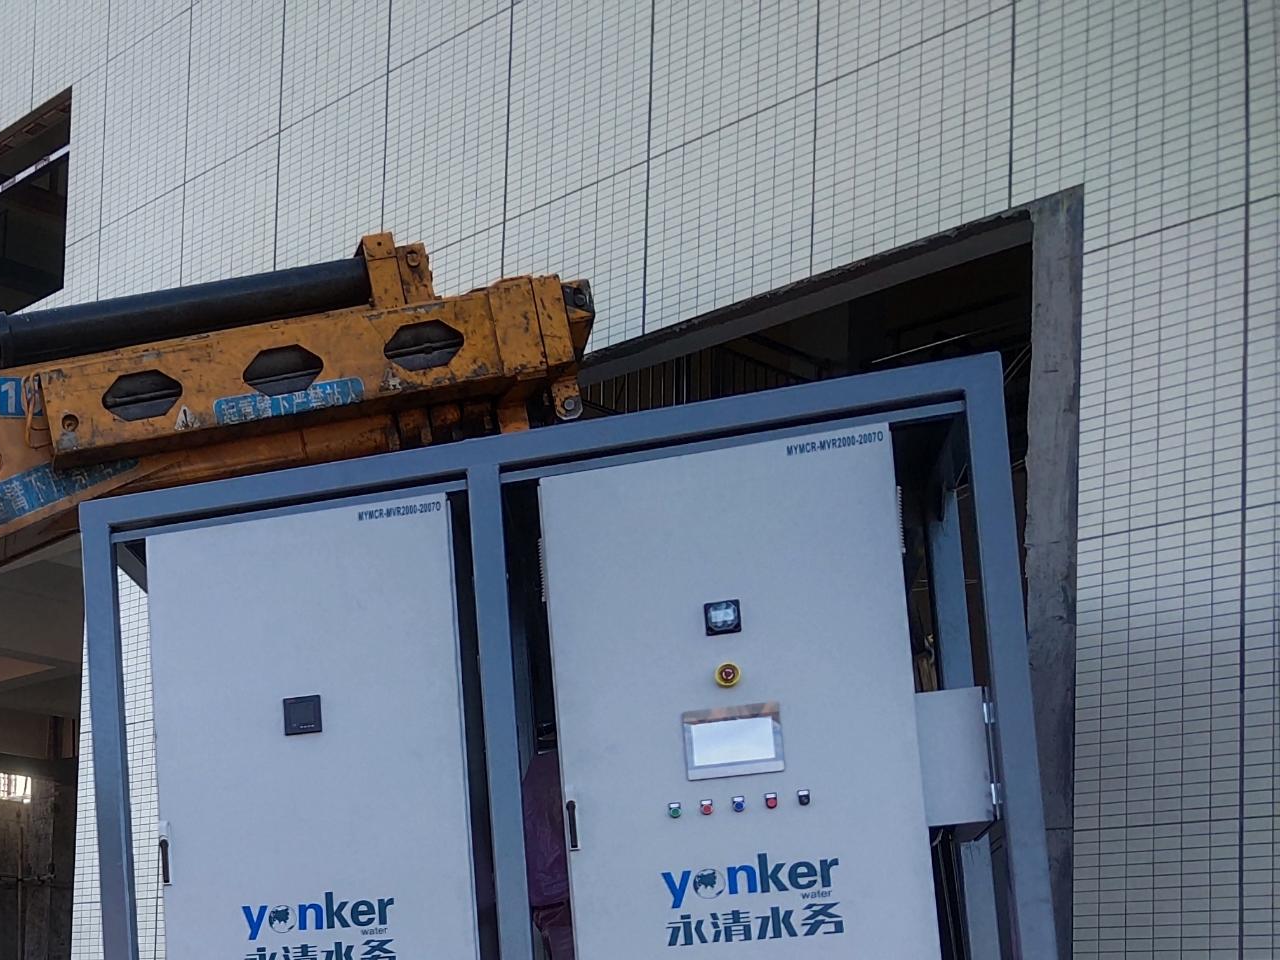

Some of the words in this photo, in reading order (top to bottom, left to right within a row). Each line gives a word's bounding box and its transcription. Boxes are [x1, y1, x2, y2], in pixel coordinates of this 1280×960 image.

[661, 852, 840, 909] yonker
[800, 889, 833, 900] water
[241, 891, 395, 941] yonker
[361, 926, 389, 936] water
[665, 901, 845, 947] 永清水务
